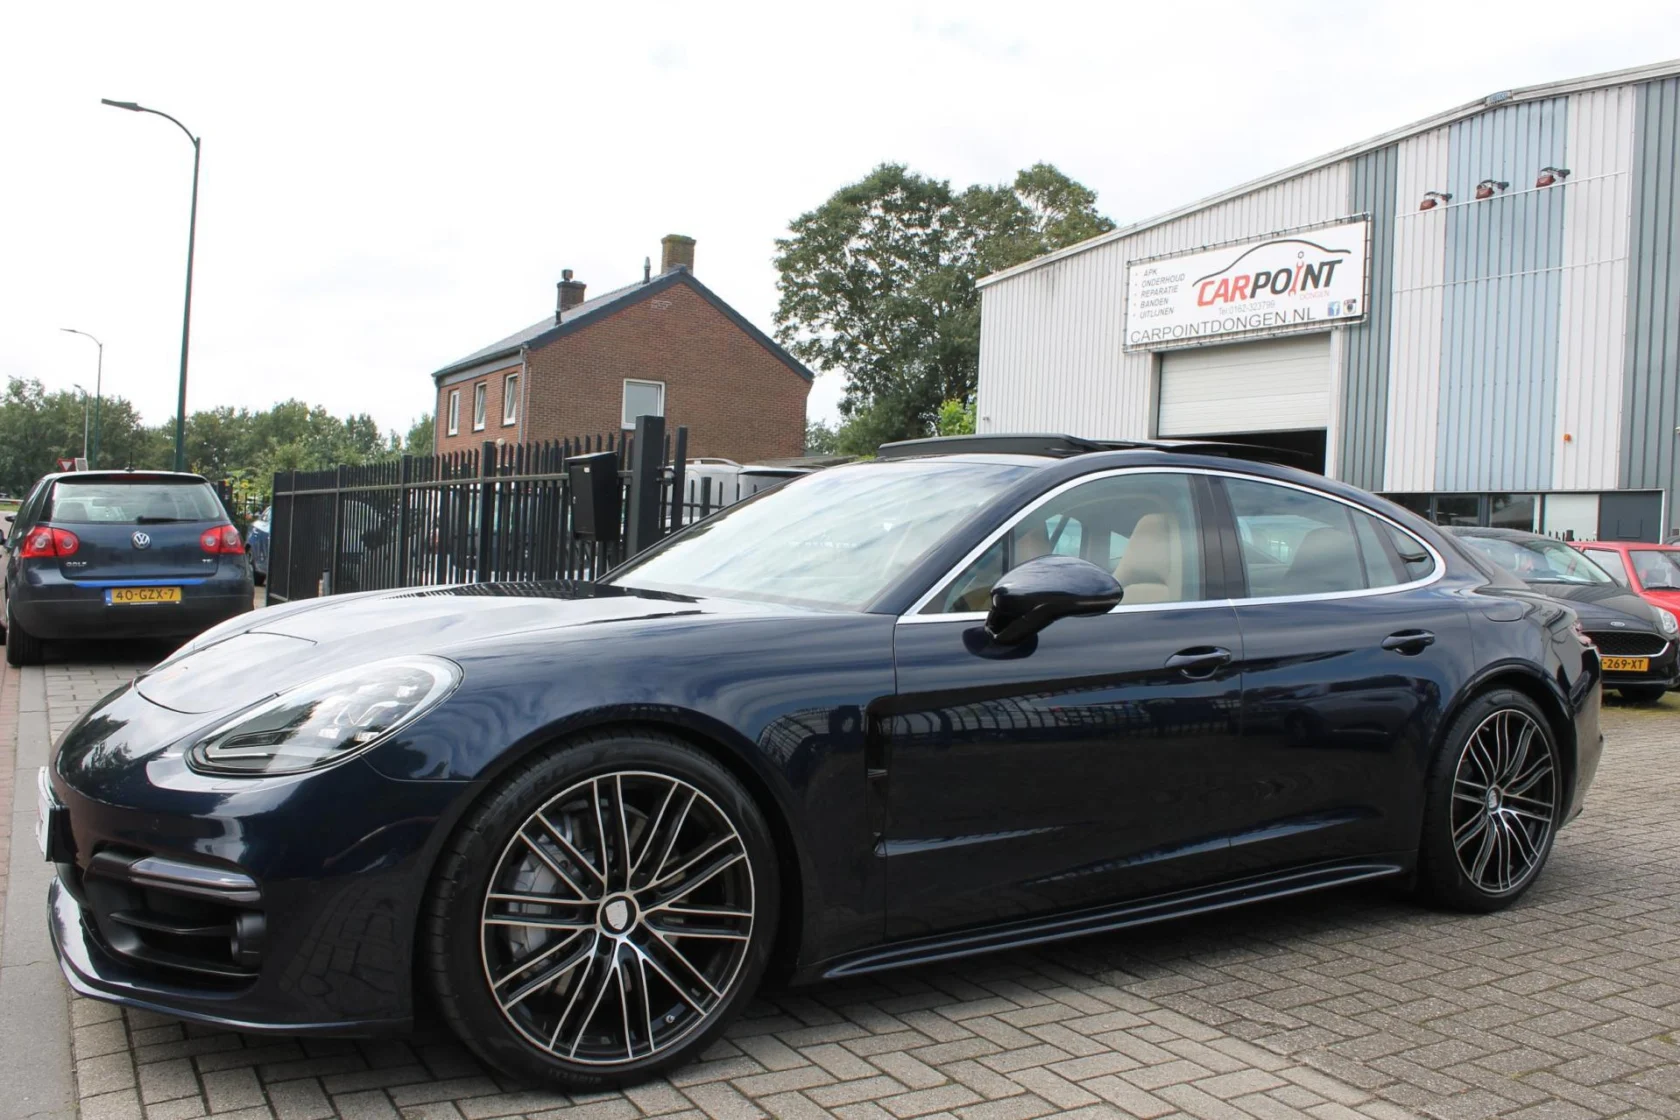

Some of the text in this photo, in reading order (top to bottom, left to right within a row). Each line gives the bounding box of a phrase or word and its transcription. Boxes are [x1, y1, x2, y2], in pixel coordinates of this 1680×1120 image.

[1144, 268, 1158, 277] APK
[1141, 273, 1186, 288] ONDERHOUD
[1196, 256, 1343, 307] CARPOINT
[1140, 284, 1179, 299] REPARATIE
[1140, 297, 1169, 309] BANDEN
[1139, 306, 1175, 319] UITLIJNEN
[1130, 307, 1317, 343] CARPOINTDONGEN.NL
[116, 588, 175, 600] 40-GZX-7
[1600, 658, 1644, 669] -269-XT
